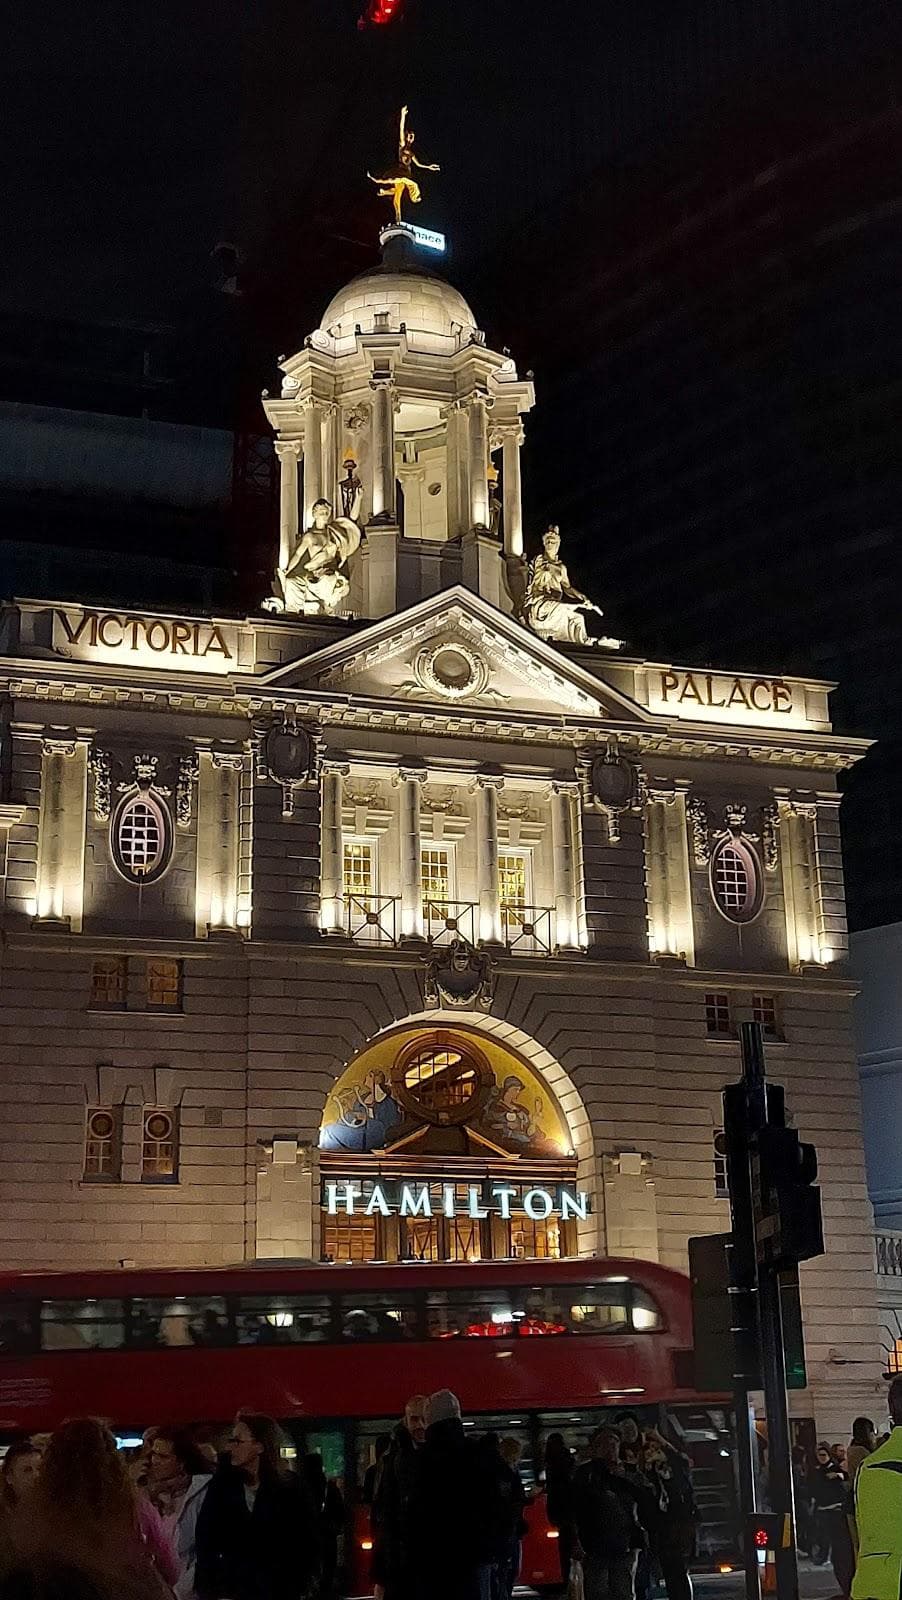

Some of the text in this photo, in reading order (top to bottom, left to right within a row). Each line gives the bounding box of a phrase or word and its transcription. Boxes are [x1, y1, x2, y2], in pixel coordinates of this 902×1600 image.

[54, 608, 233, 659] VICTORIA
[660, 670, 793, 714] PALACE
[325, 1184, 588, 1221] HAMILTON
